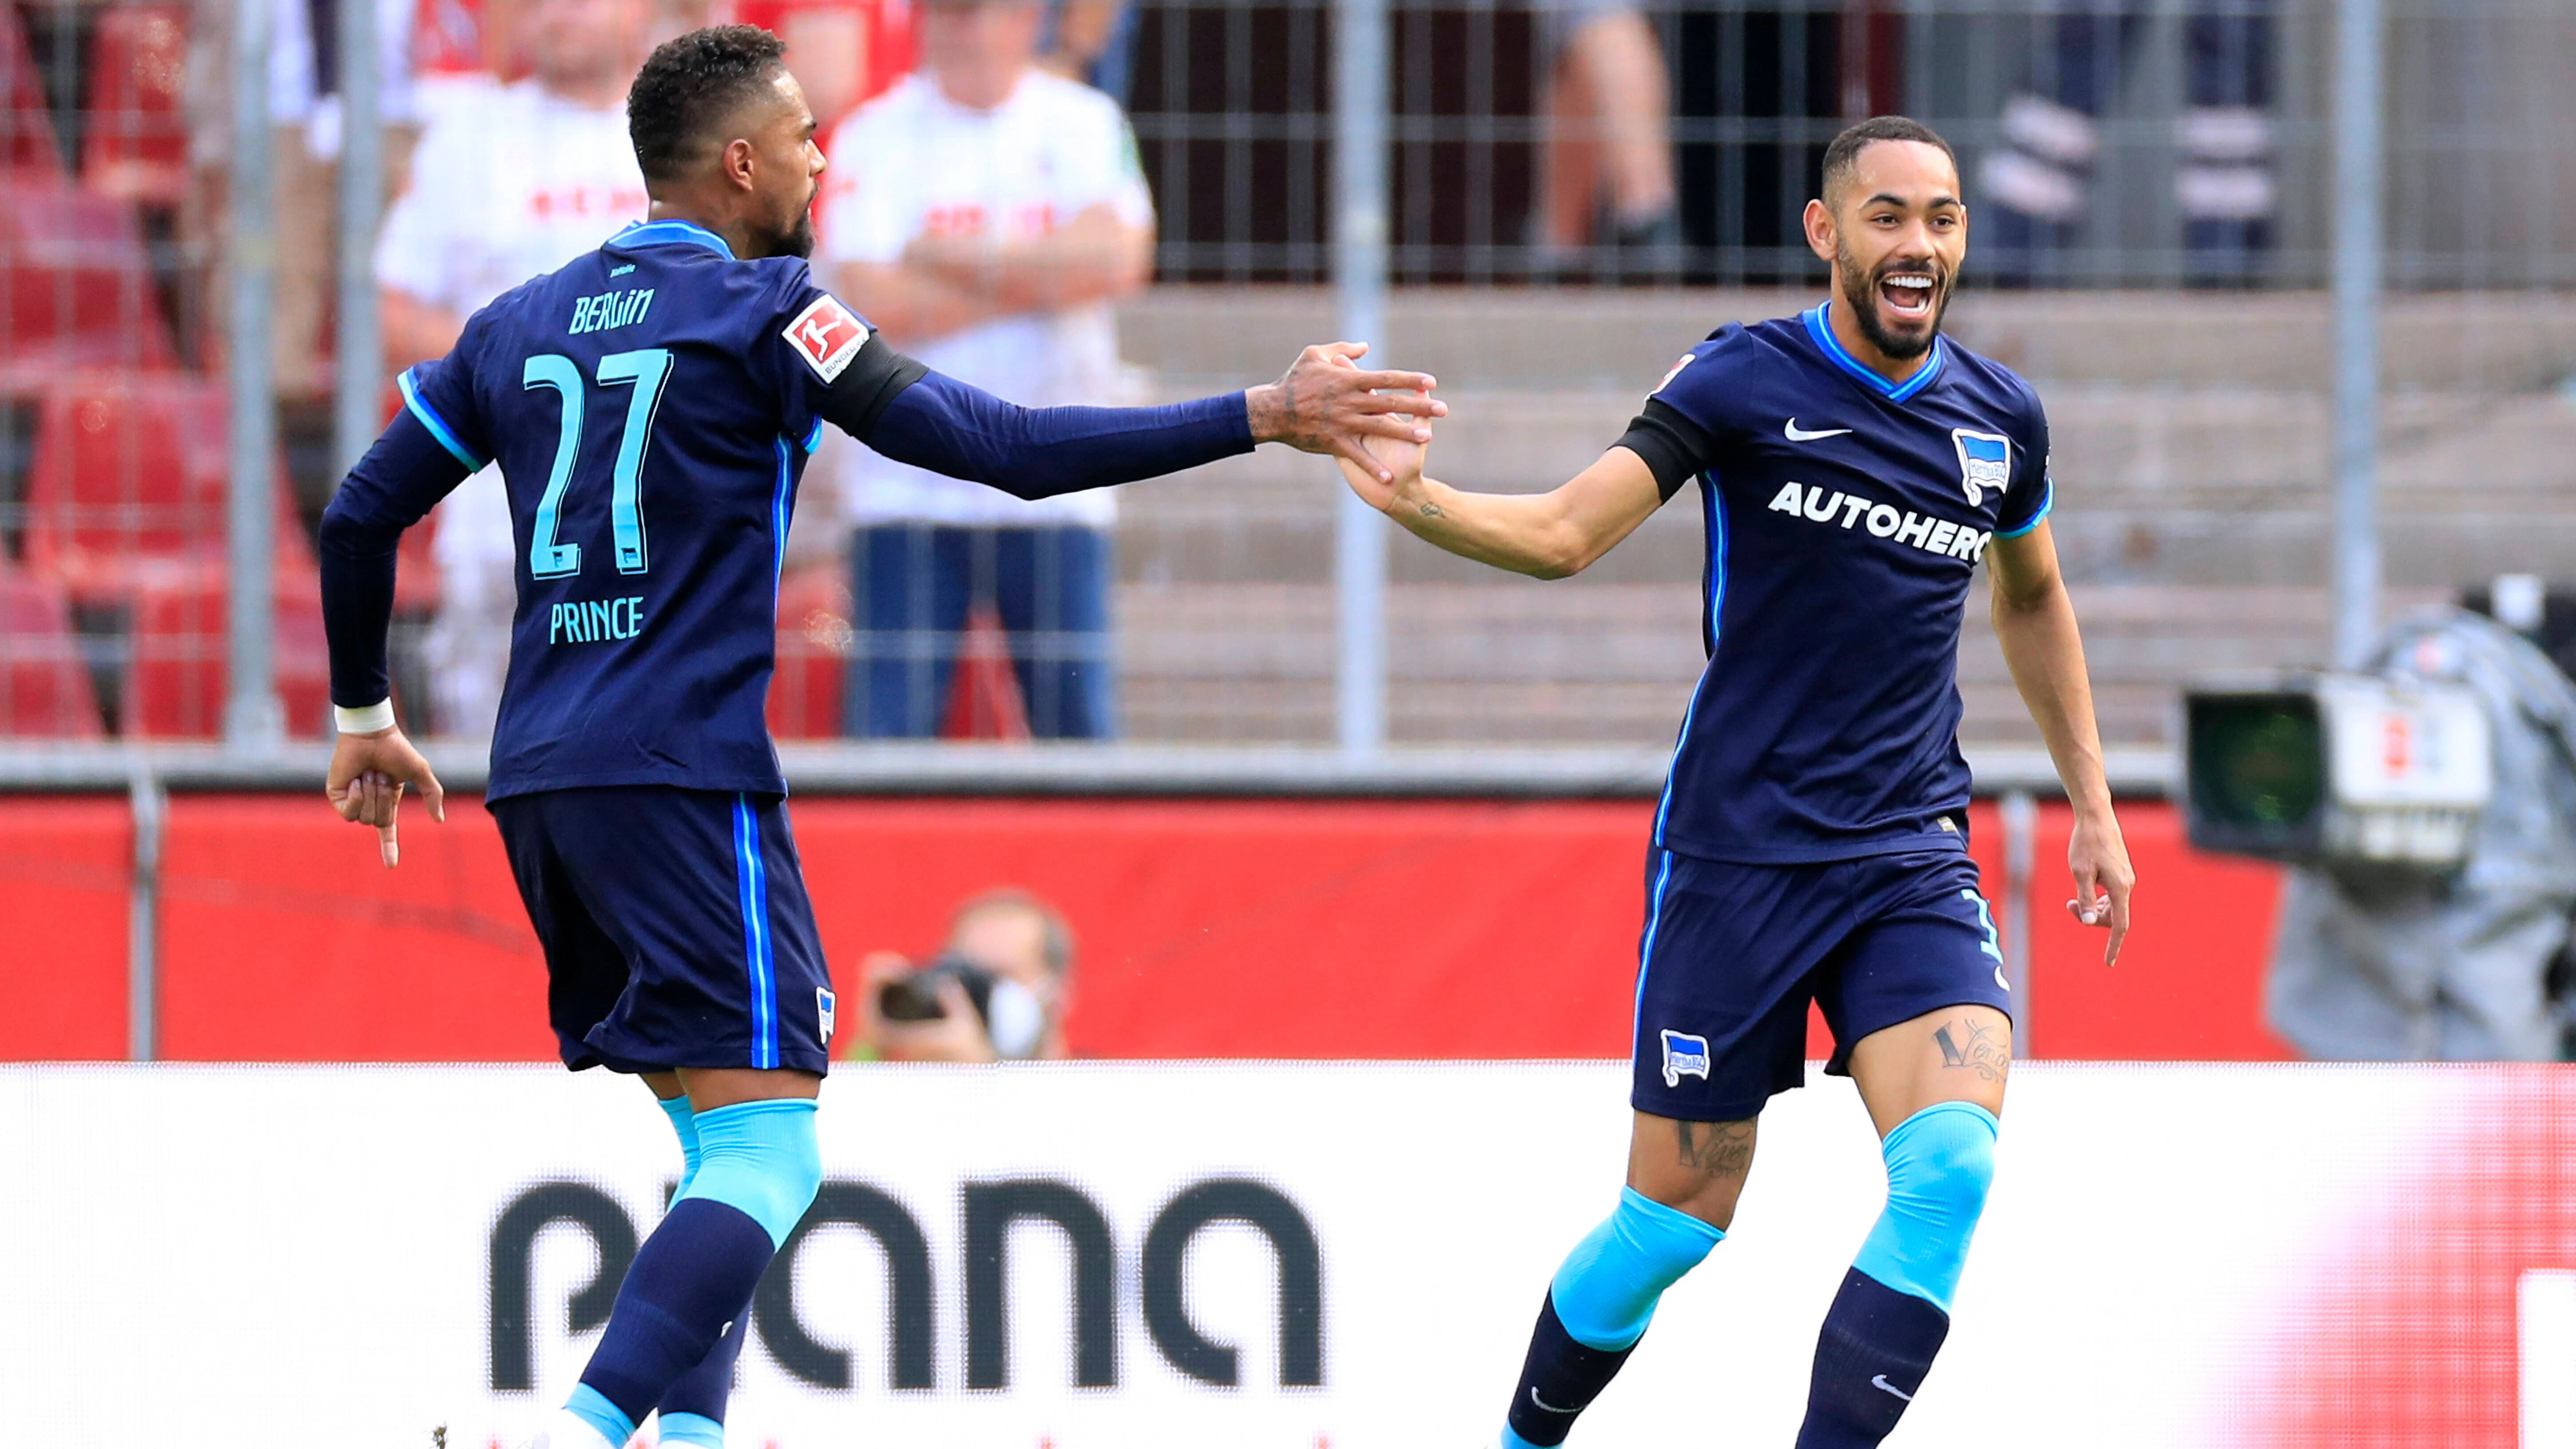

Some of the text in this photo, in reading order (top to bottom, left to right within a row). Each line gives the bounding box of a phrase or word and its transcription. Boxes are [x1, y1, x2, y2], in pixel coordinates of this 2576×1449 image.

[523, 348, 674, 580] 27
[550, 596, 644, 645] PRINCE
[489, 1179, 1321, 1390] pana
